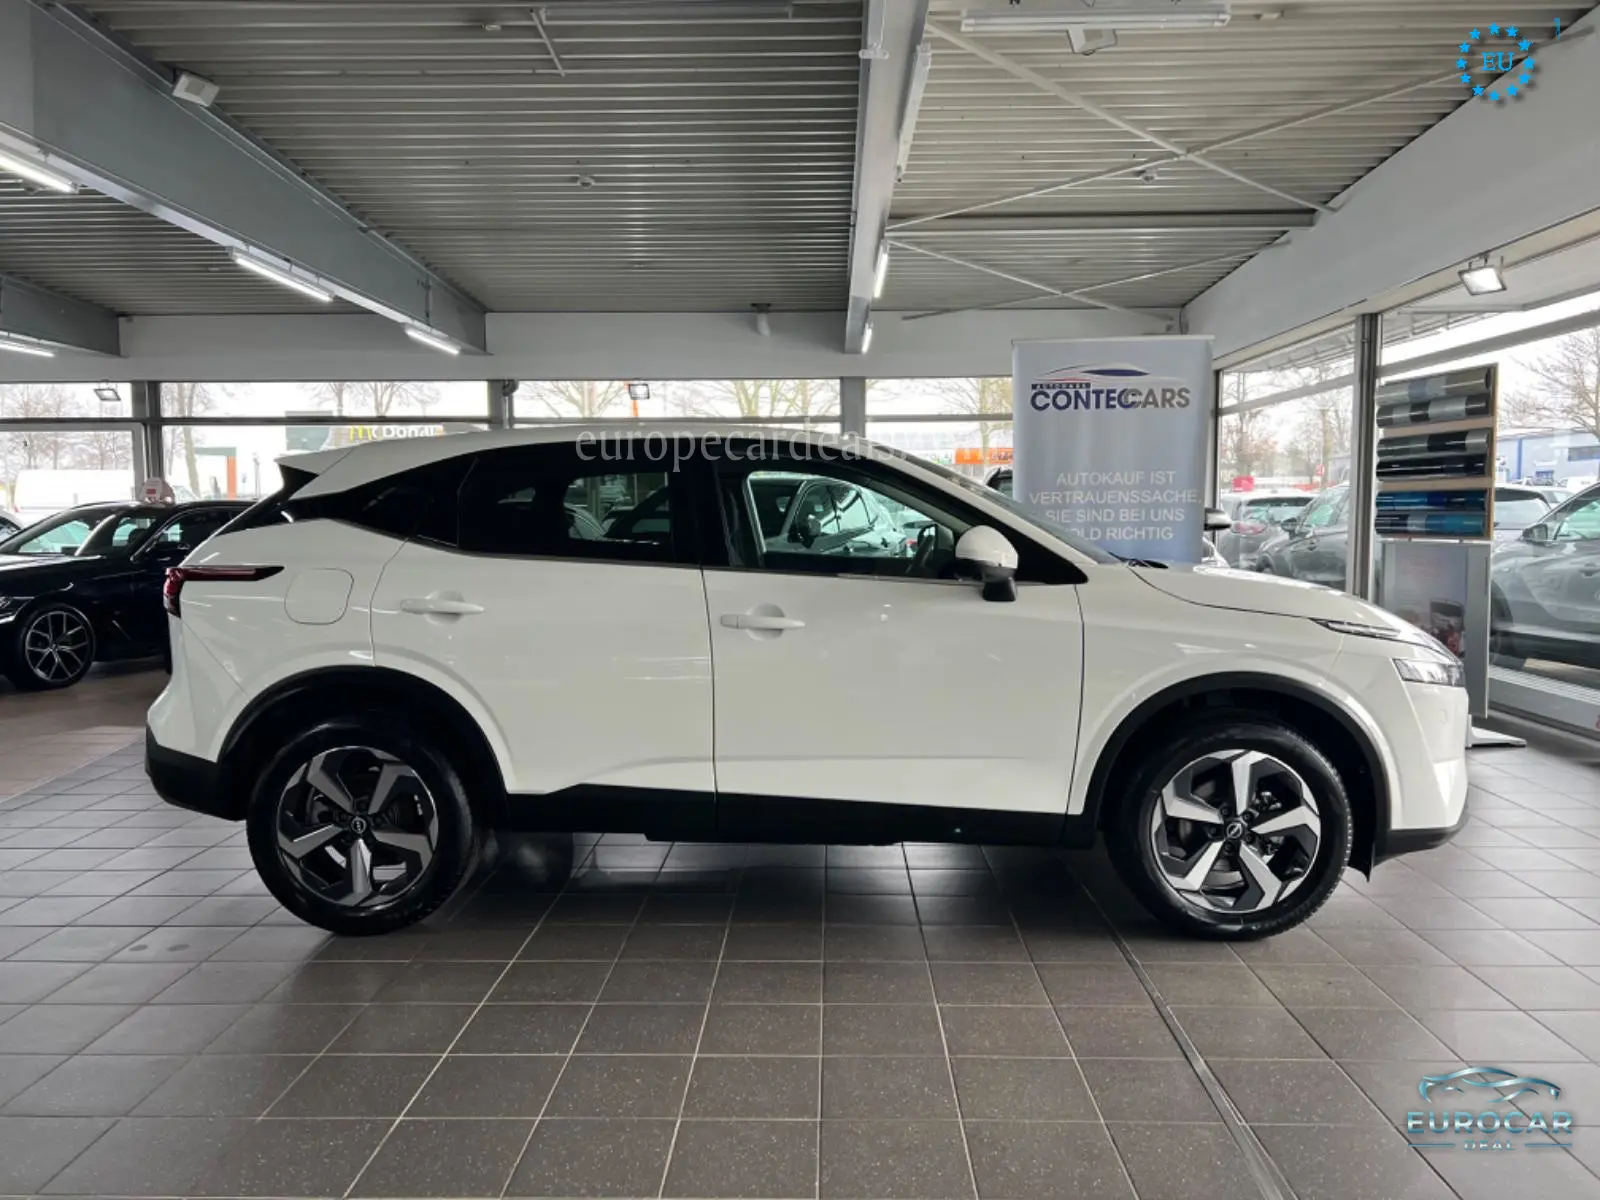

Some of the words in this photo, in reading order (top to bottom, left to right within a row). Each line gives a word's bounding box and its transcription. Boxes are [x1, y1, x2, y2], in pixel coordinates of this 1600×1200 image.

[1030, 387, 1191, 411] CONTECCARS
[1056, 472, 1145, 486] AUTOKAUF
[1150, 471, 1177, 484] IST
[1045, 509, 1072, 523] SIE
[1076, 509, 1115, 522] SIND
[1119, 509, 1145, 521] BEI
[1150, 507, 1185, 521] UNS
[1106, 527, 1174, 541] RICHTIG
